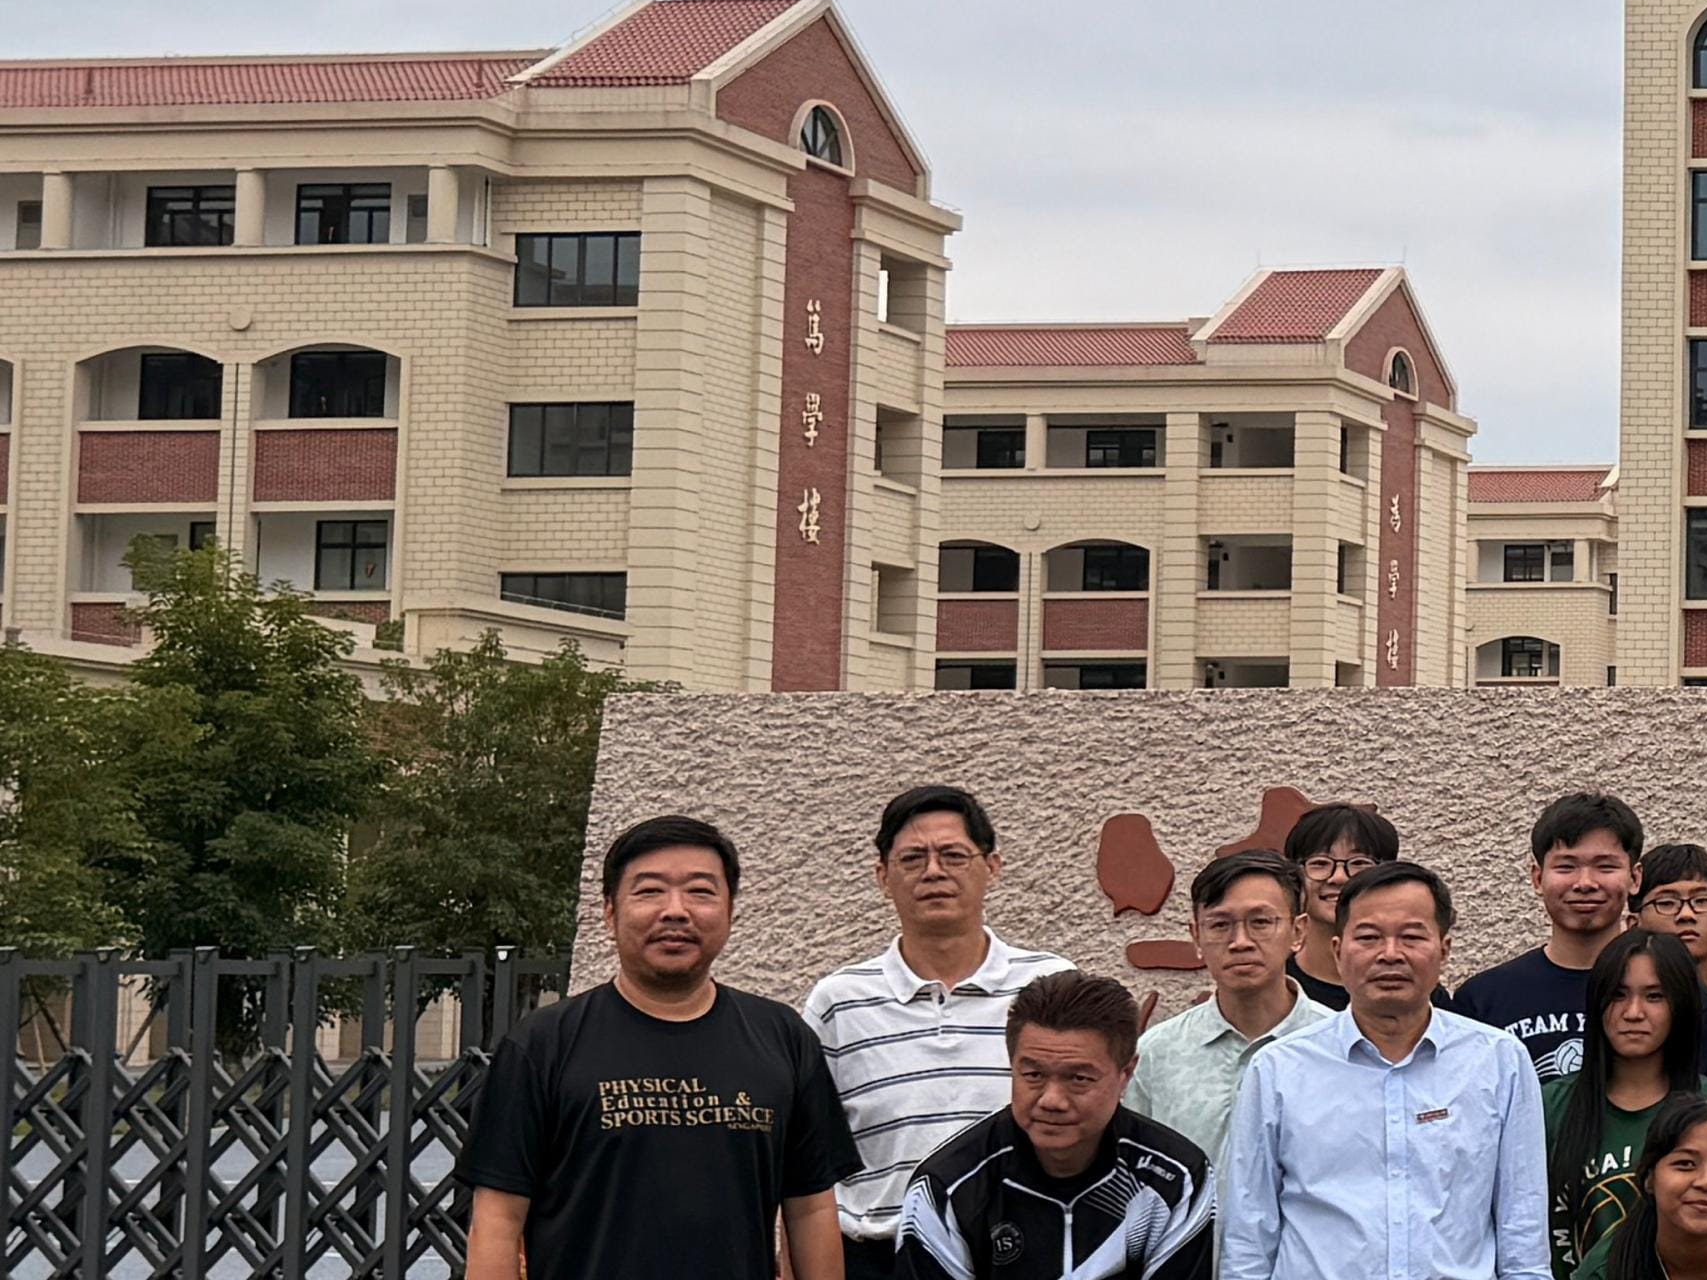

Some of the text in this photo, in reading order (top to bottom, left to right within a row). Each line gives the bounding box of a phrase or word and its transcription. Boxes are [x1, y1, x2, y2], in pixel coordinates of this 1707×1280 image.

[1505, 1013, 1568, 1038] TEAM
[599, 1078, 707, 1096] PHYSICAL
[601, 1091, 752, 1112] Education &
[600, 1106, 775, 1130] SPORTS SCIENCE
